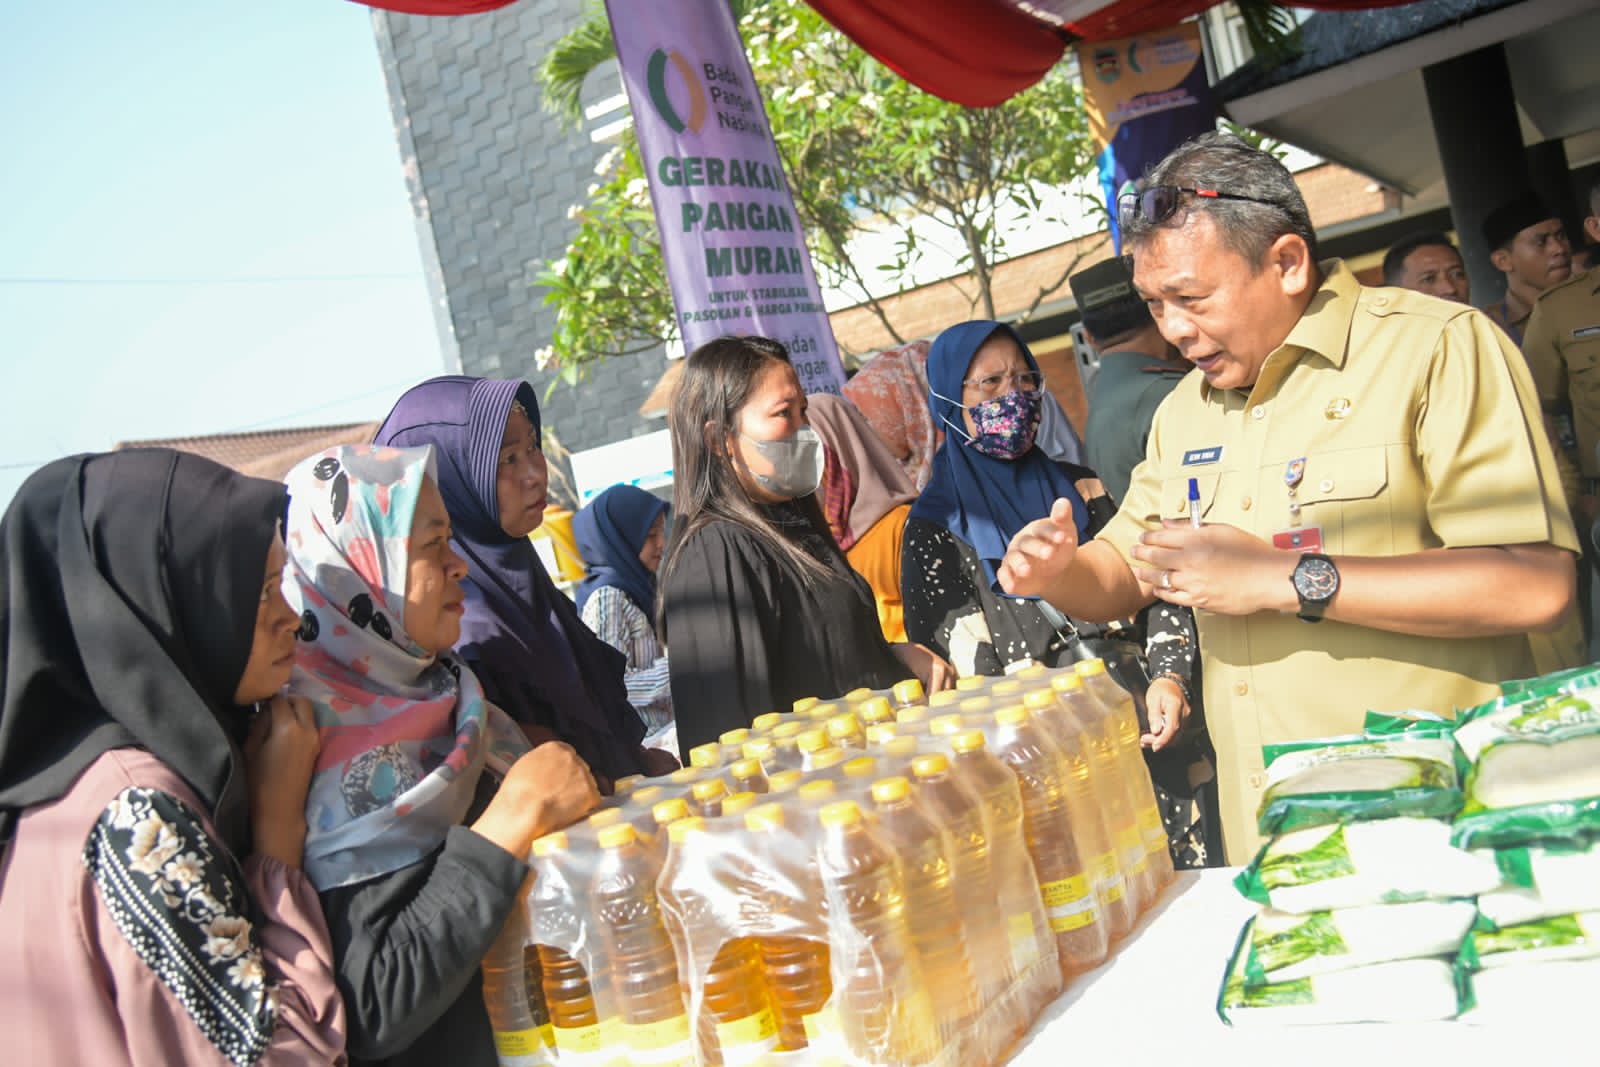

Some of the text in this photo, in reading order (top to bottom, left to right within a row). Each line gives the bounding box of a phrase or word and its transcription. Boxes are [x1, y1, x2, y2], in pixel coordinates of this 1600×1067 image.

[681, 202, 793, 232] PANGAN
[704, 246, 803, 277] MURAH
[709, 290, 748, 304] UNTUK
[683, 307, 740, 324] PASOKAN
[757, 303, 792, 316] HARGA
[783, 335, 817, 353] adan
[795, 360, 832, 381] ngan
